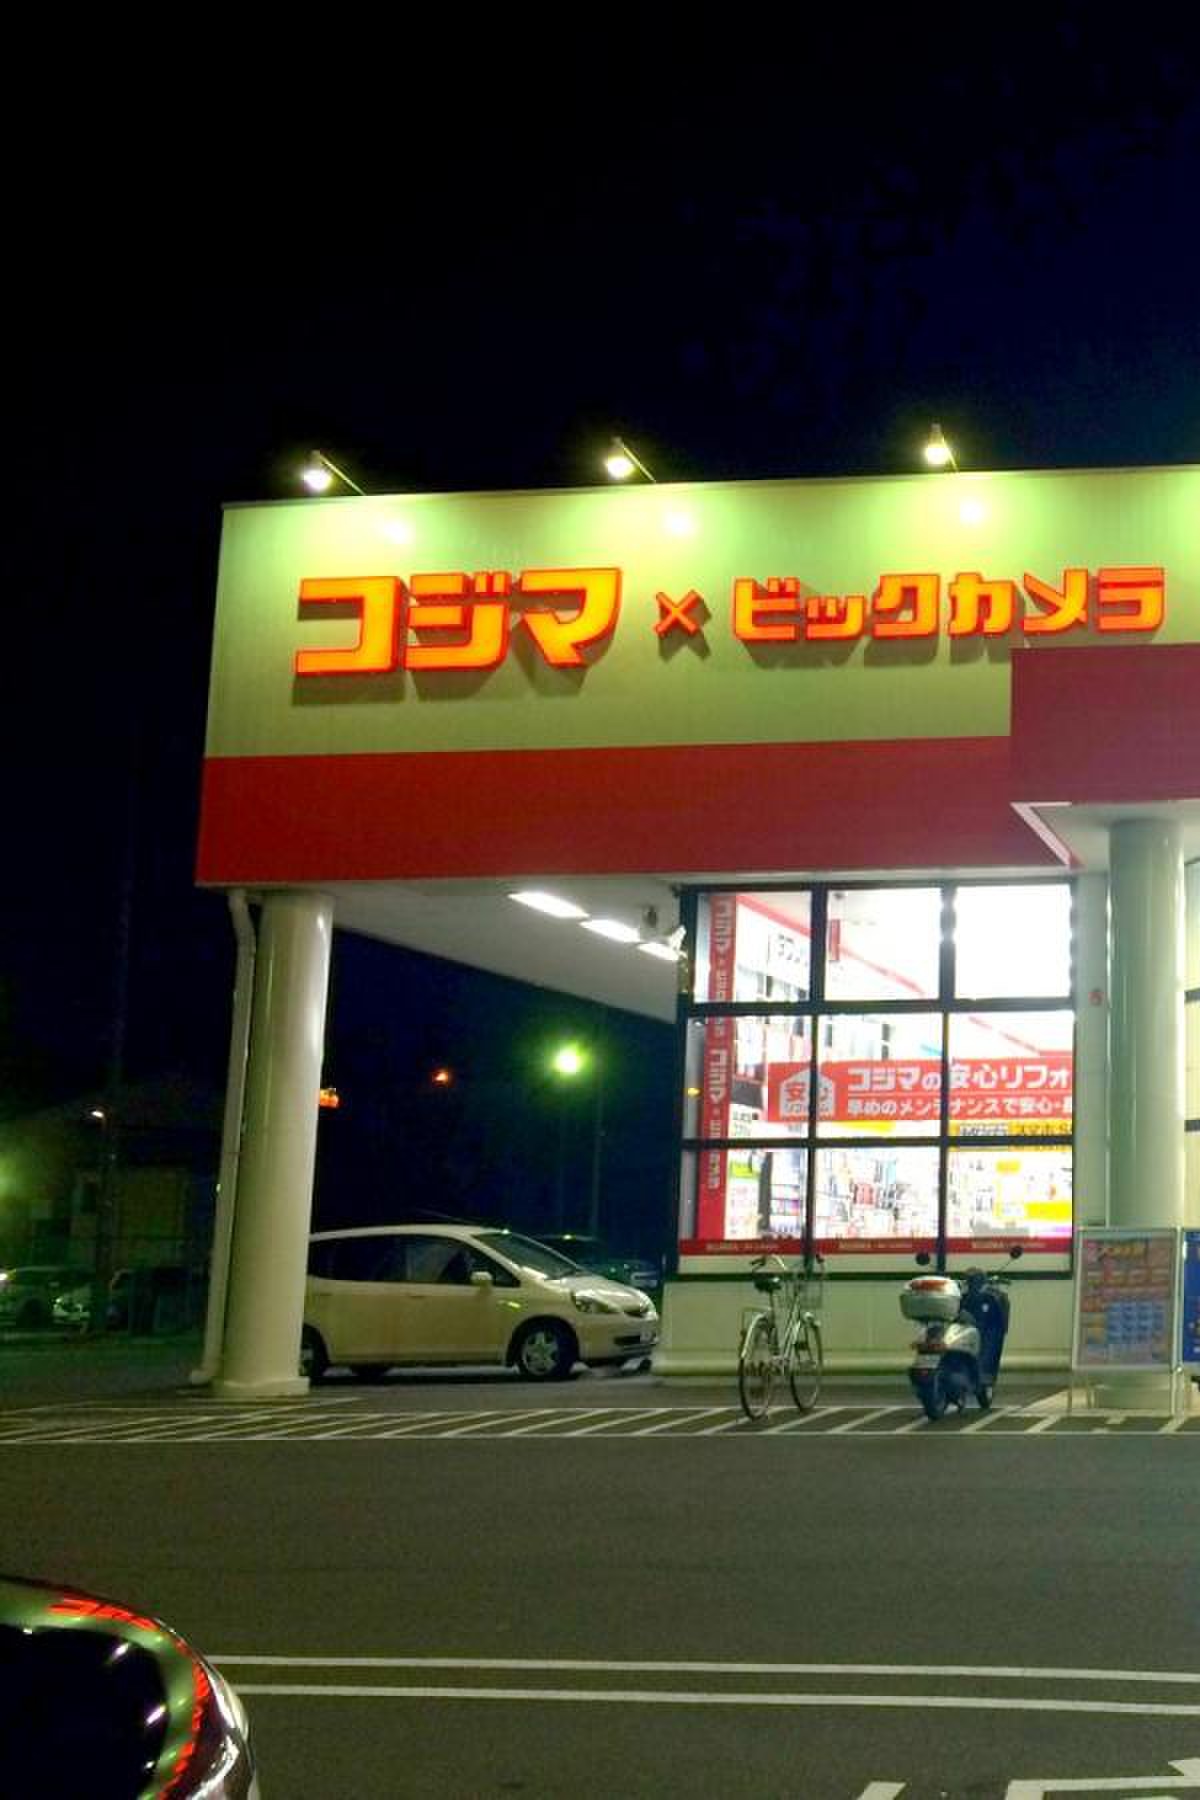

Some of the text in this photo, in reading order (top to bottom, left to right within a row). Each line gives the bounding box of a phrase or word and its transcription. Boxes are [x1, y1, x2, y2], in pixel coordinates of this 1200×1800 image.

[294, 567, 622, 677] コジマ
[732, 567, 1166, 643] ビックカメラ
